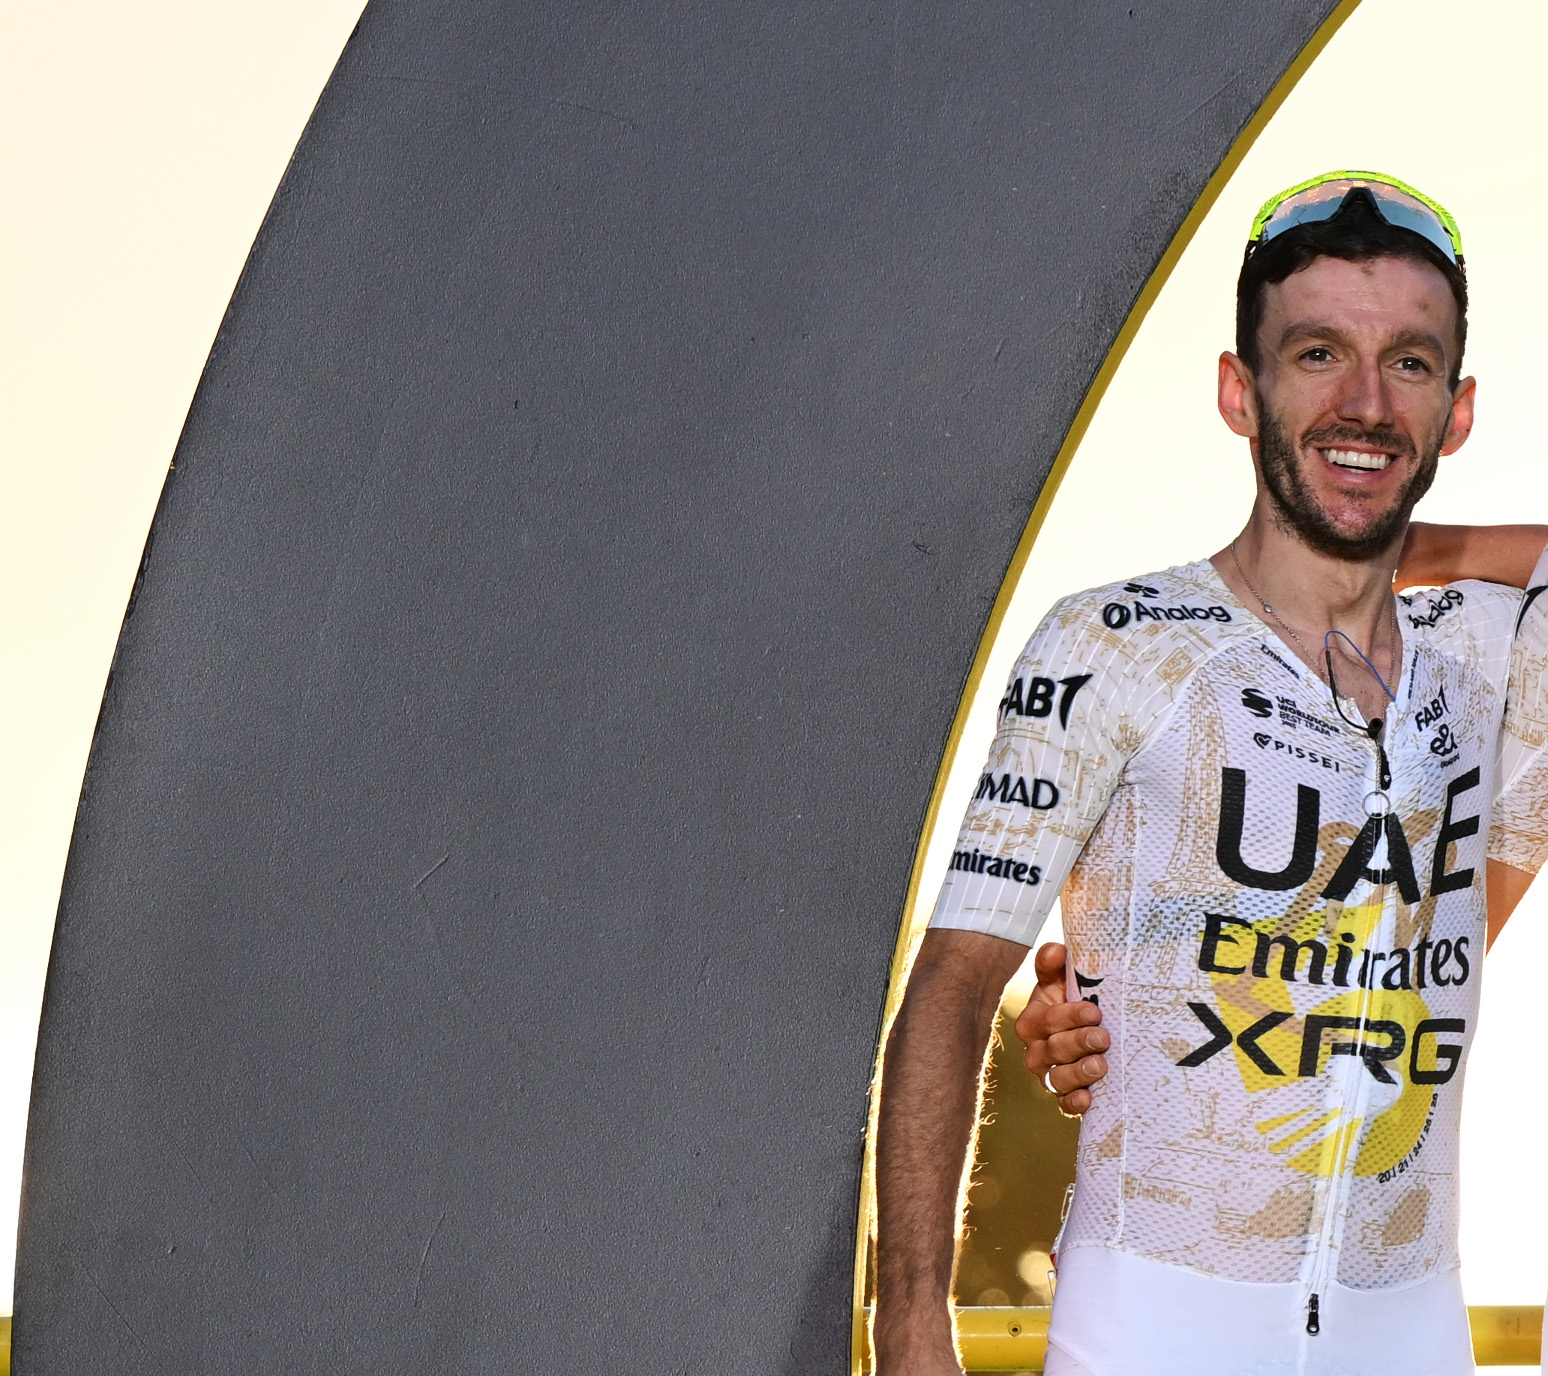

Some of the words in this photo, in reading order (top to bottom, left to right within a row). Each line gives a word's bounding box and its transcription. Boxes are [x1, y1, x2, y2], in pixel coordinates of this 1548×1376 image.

[1134, 601, 1232, 623] Analog
[1275, 741, 1339, 773] PISSEI
[1216, 766, 1480, 905] UAE
[950, 847, 1041, 886] mirates
[1200, 912, 1470, 992] Emirates
[1176, 1001, 1466, 1086] XRG
